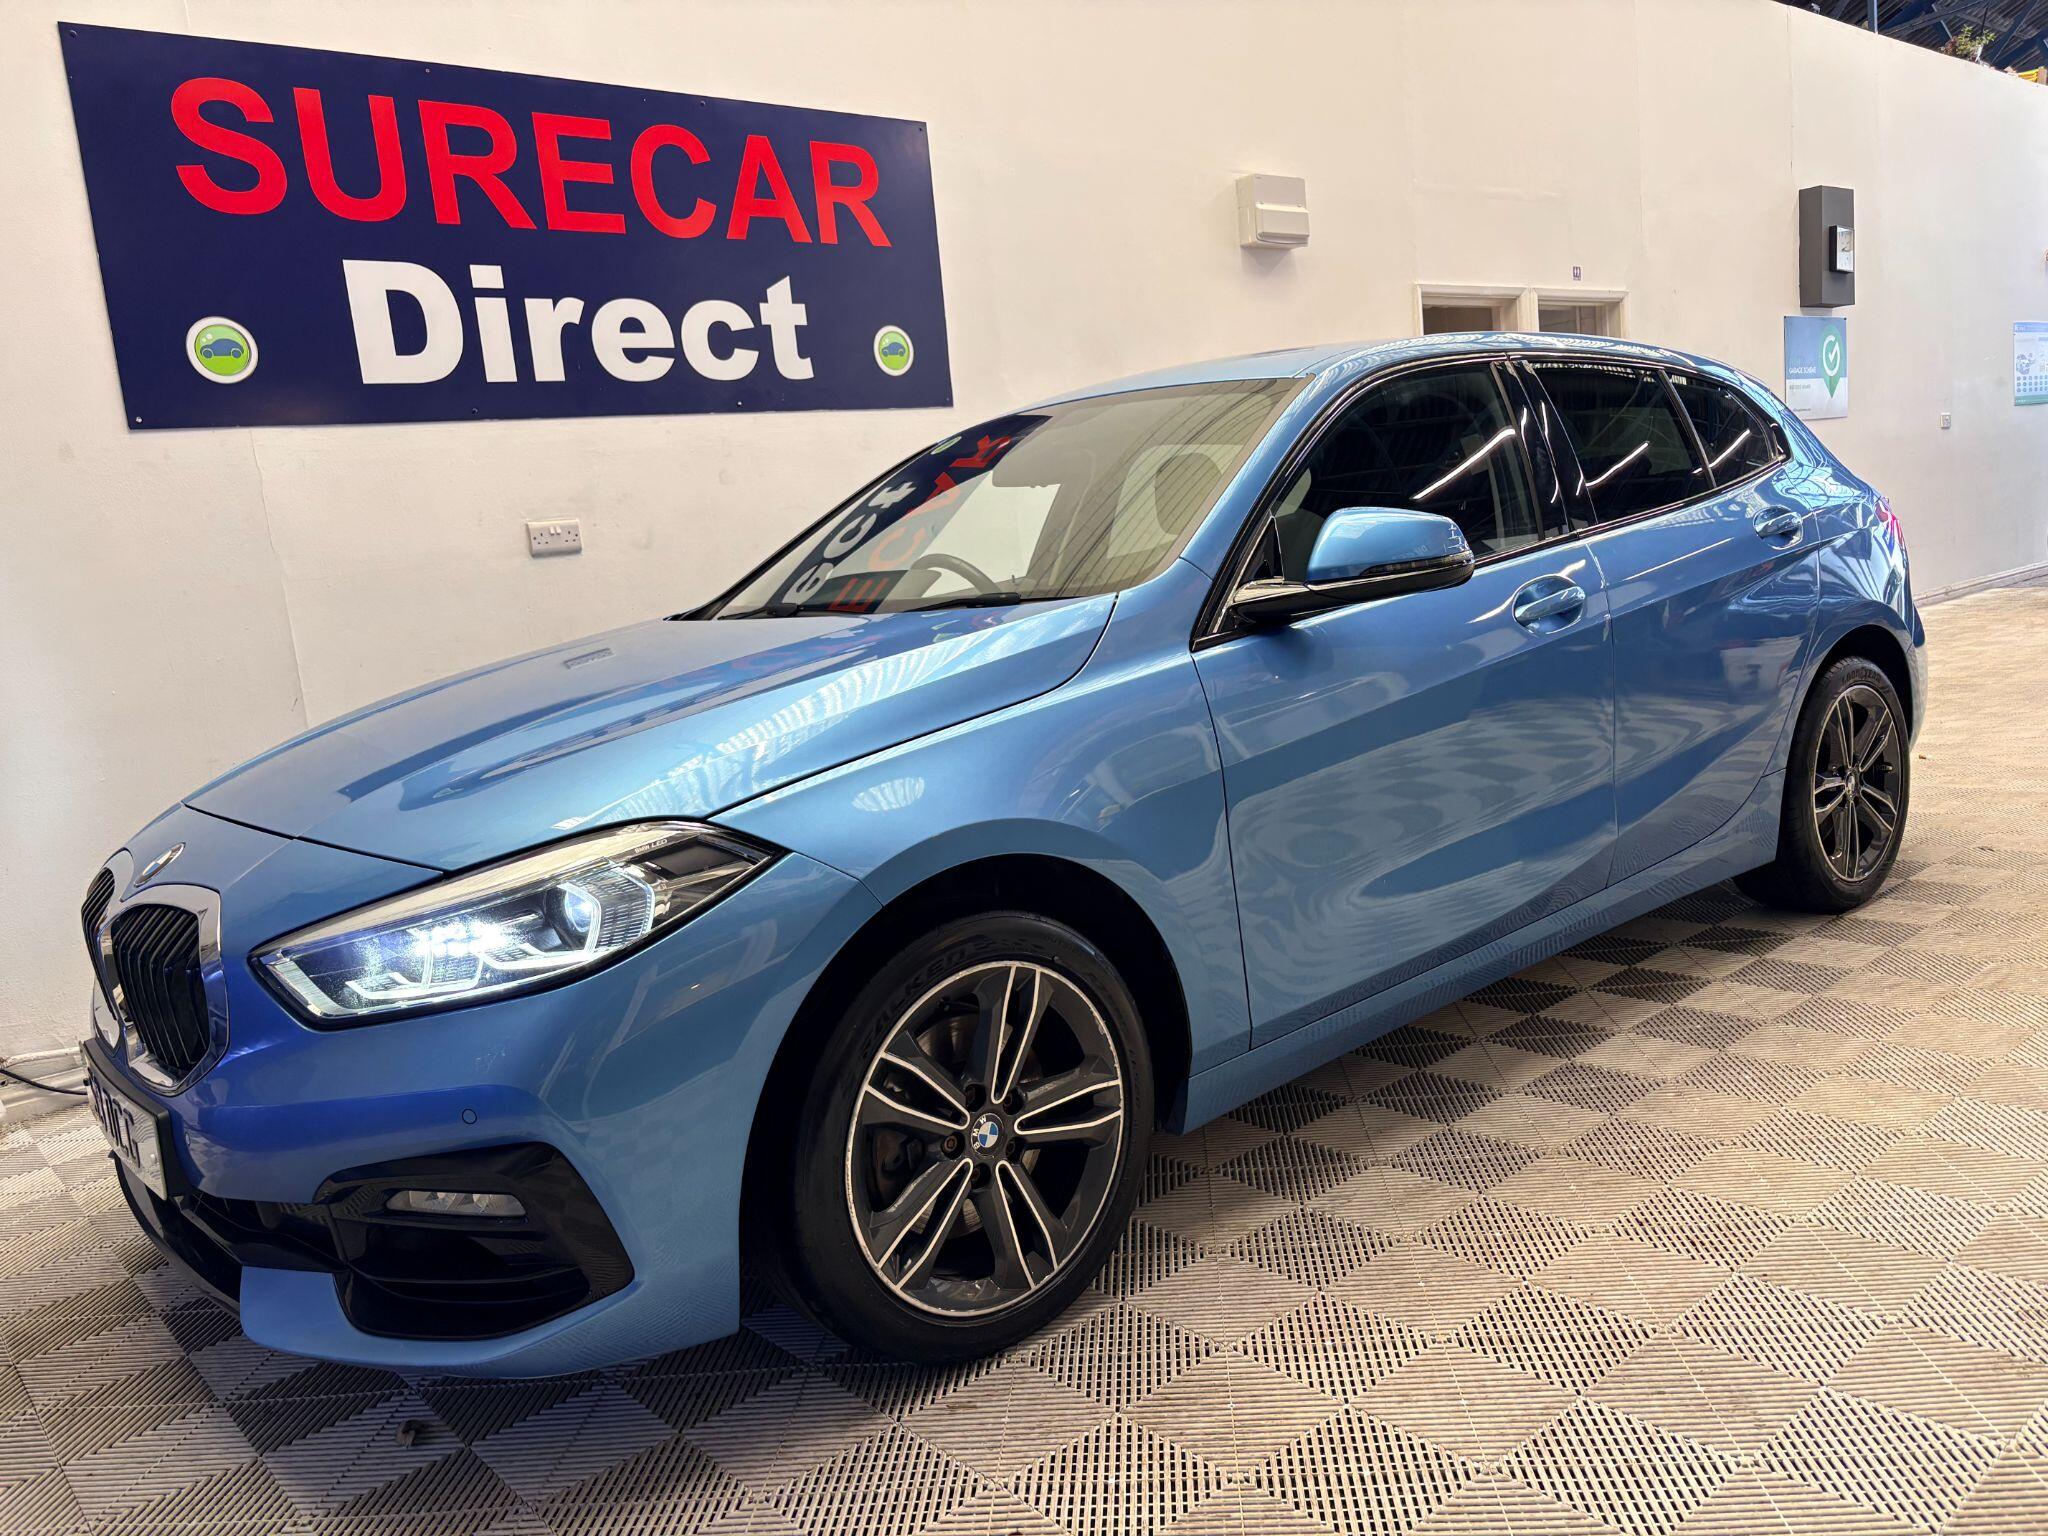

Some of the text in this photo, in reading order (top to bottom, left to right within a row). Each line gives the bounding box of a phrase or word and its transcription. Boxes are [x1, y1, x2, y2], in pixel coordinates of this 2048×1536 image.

[170, 76, 892, 248] SURECAR
[342, 258, 815, 385] Direct
[651, 838, 668, 848] LED
[972, 1114, 987, 1150] BMW
